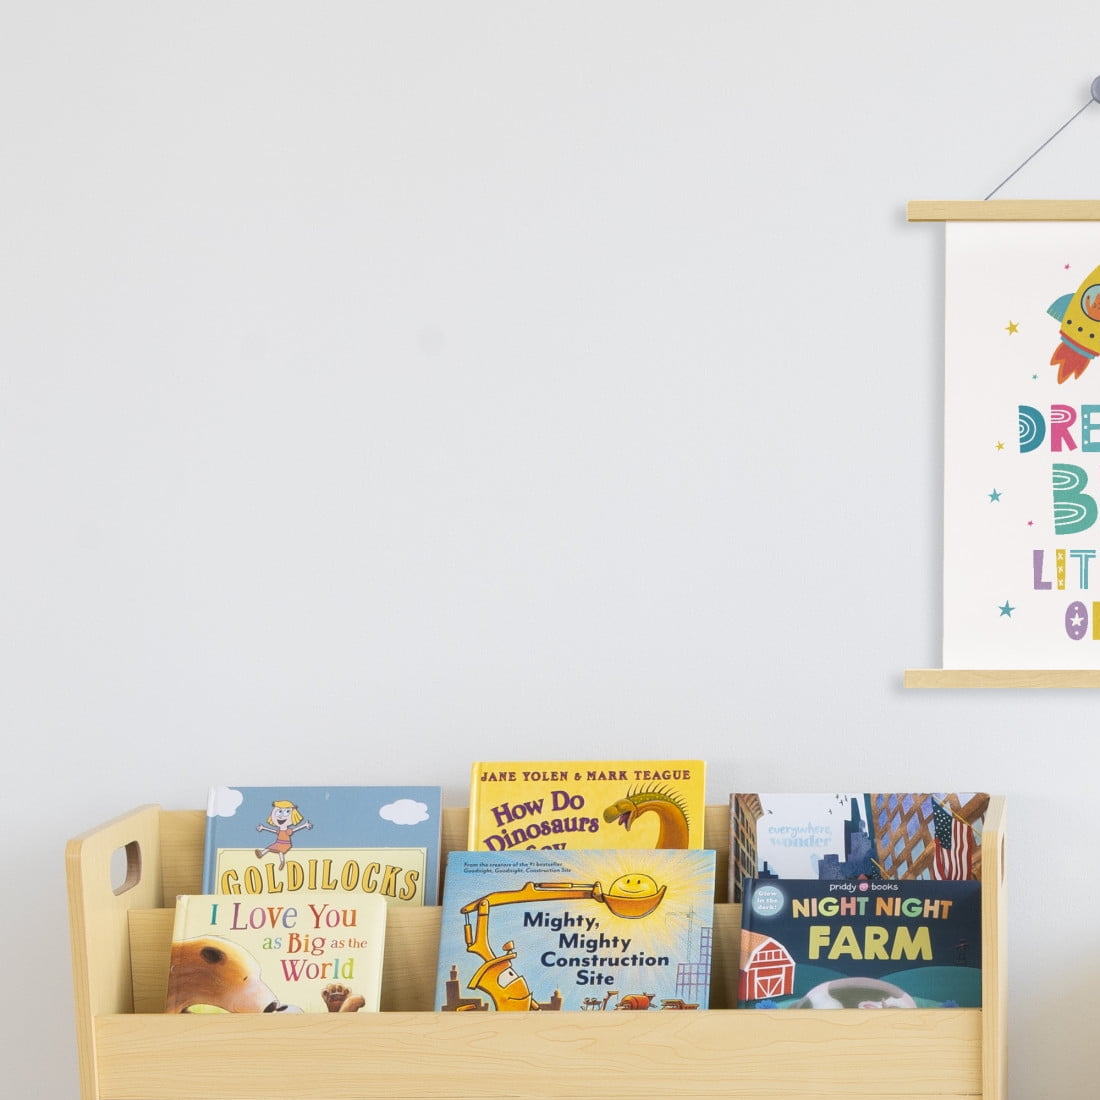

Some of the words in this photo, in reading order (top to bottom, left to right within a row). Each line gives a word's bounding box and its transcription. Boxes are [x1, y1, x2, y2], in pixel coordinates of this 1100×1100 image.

[481, 771, 517, 782] JANE
[523, 771, 568, 782] YOLEN
[574, 771, 582, 782] &
[586, 770, 628, 781] MARK
[634, 769, 691, 781] TEAGUE
[490, 798, 545, 828] How
[551, 790, 585, 812] Do
[483, 816, 600, 851] Dinosaurs
[769, 834, 832, 848] wonder
[221, 858, 419, 900] GOLDILOCKS
[829, 882, 857, 893] priddy
[871, 882, 899, 891] books
[209, 903, 219, 926] I
[229, 902, 298, 931] Love
[308, 903, 358, 929] You
[792, 896, 869, 919] NIGHT
[875, 896, 953, 920] NIGHT
[523, 911, 600, 931] Mighty,
[262, 936, 283, 950] as
[286, 932, 327, 956] Big
[330, 938, 345, 949] as
[348, 937, 368, 949] the
[558, 933, 632, 952] Mighty
[808, 925, 933, 961] FARM
[280, 956, 355, 982] World
[540, 951, 670, 968] Construction
[576, 970, 614, 986] Site
